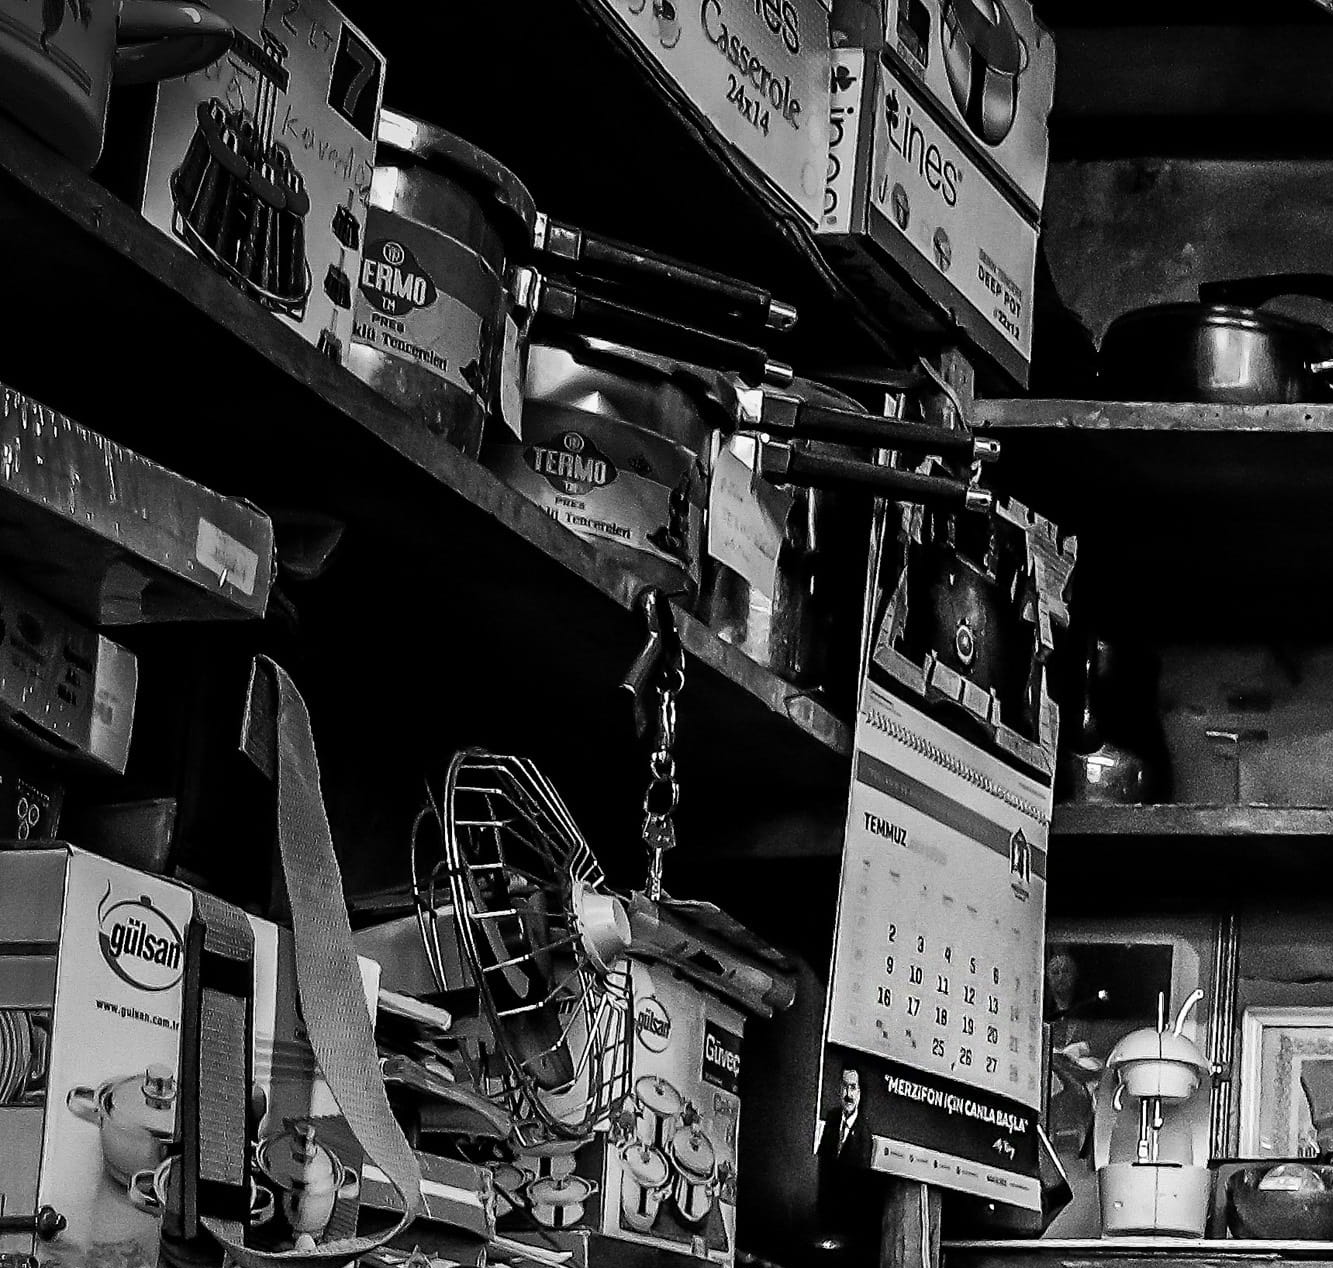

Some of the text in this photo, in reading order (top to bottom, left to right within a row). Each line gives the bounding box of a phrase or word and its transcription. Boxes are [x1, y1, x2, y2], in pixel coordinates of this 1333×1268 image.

[701, 0, 800, 130] Casserole
[726, 74, 769, 137] 24x14
[362, 258, 427, 306] ERMO
[533, 446, 608, 485] TERMO
[864, 812, 908, 847] TEMMUZ
[110, 917, 182, 969] gülsan
[889, 924, 896, 942] 2
[917, 936, 924, 953] 3
[970, 957, 976, 974] 5
[886, 956, 893, 974] 9
[909, 965, 922, 985] 10
[937, 975, 949, 995] 11
[964, 985, 975, 1004] 12
[988, 995, 999, 1015] 13
[878, 986, 891, 1007] 16
[907, 996, 920, 1016] 17
[935, 1006, 947, 1026] 18
[962, 1016, 974, 1035] 19
[987, 1025, 998, 1044] 20
[932, 1038, 944, 1057] 25
[959, 1047, 972, 1066] 26
[986, 1056, 997, 1073] 27
